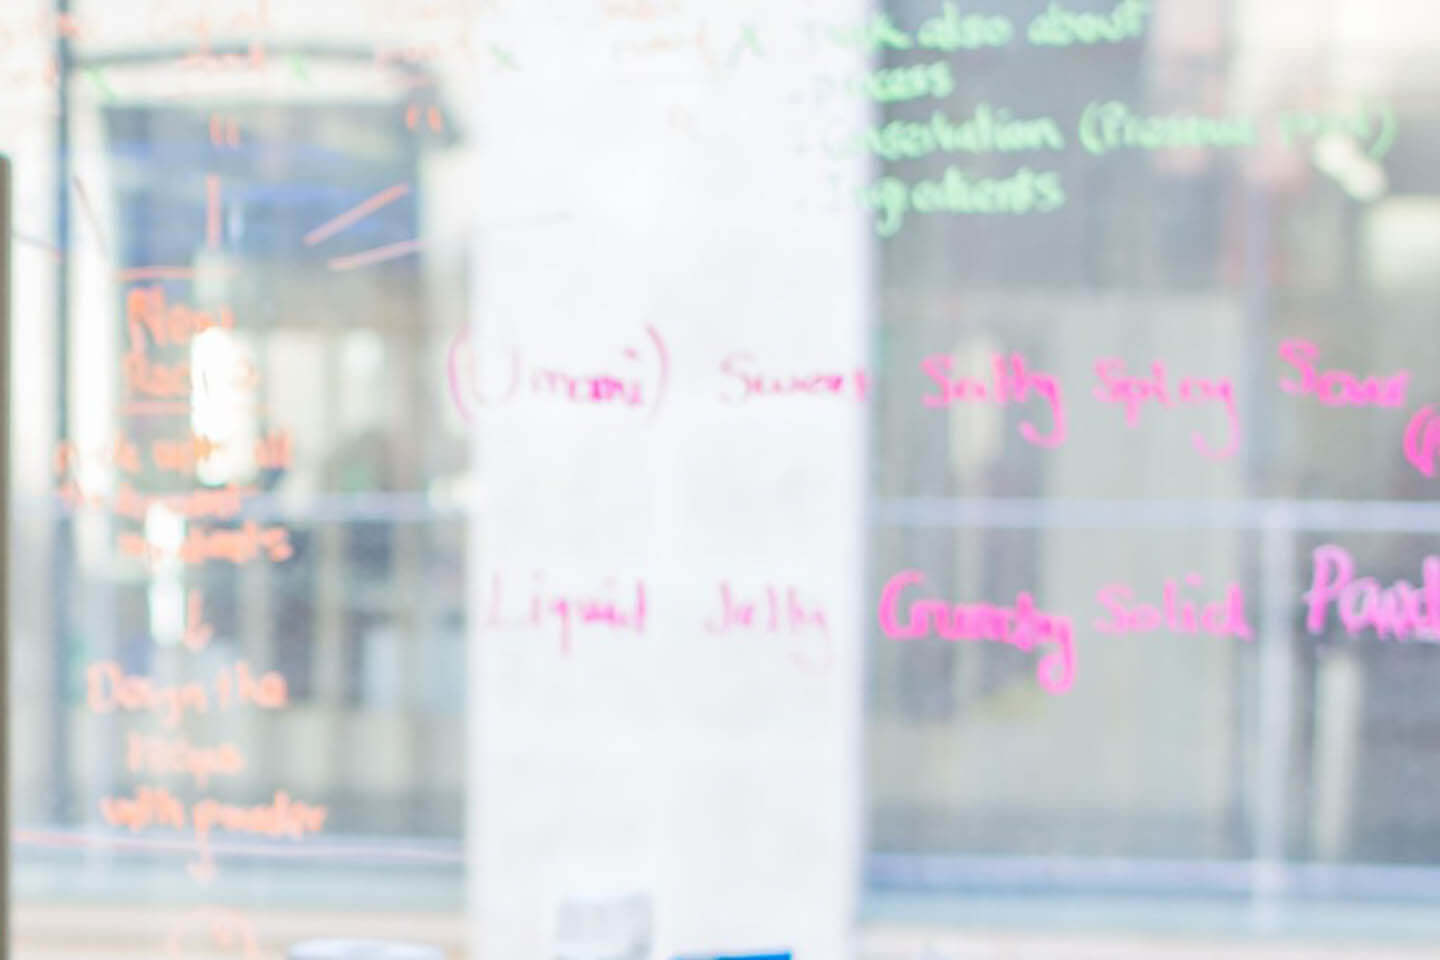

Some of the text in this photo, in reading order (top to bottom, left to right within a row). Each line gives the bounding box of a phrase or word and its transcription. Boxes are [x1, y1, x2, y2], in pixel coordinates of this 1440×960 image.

[920, 352, 1067, 449] Salty
[1092, 356, 1242, 462] Spicy
[1277, 337, 1413, 408] Sour
[484, 570, 648, 658] Liquid
[1091, 572, 1255, 642] Solid
